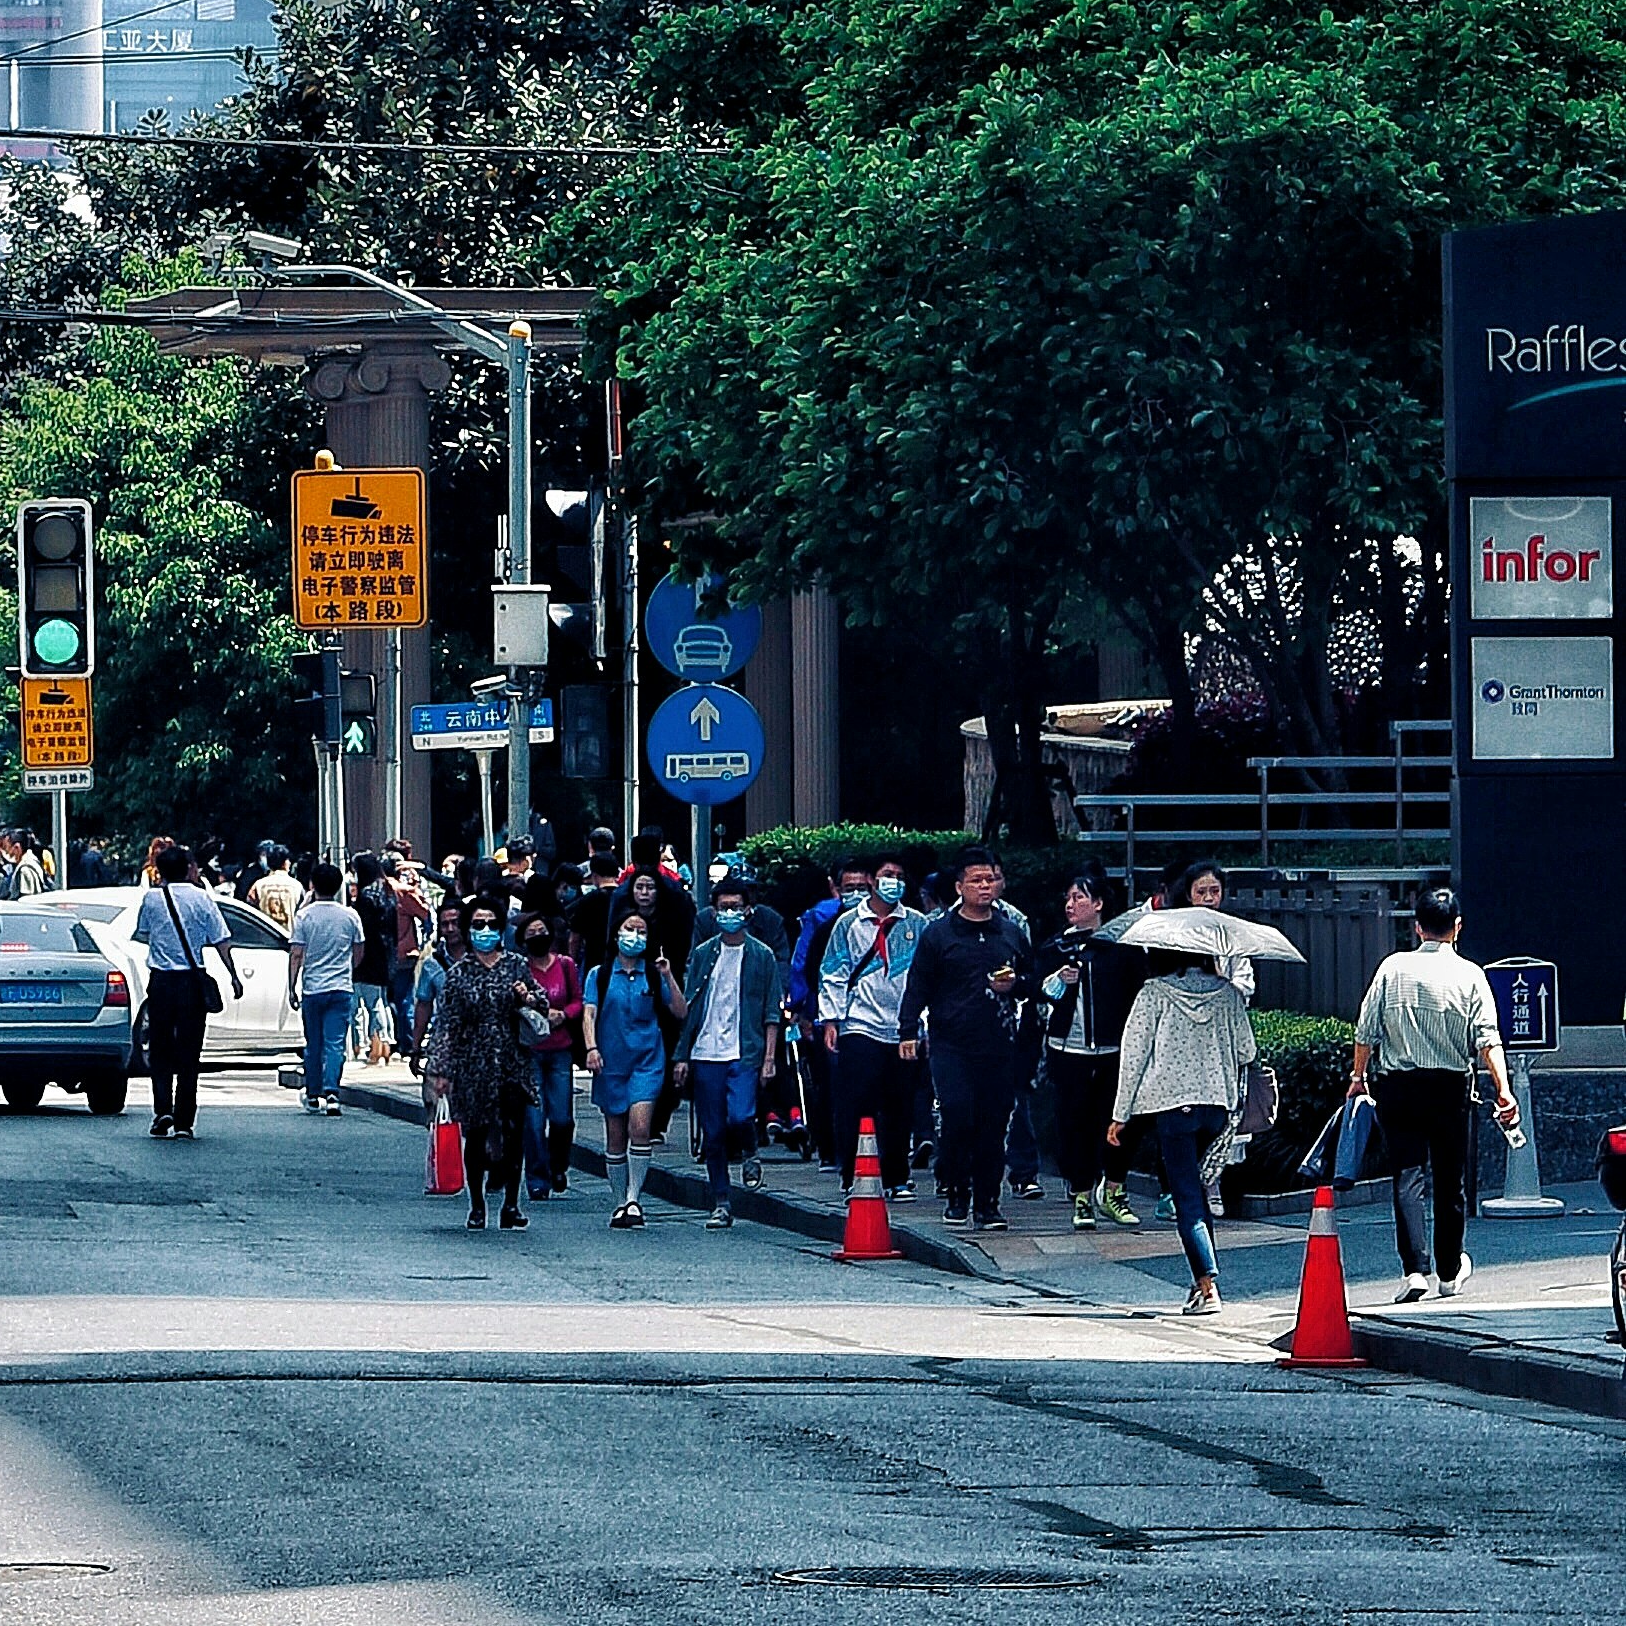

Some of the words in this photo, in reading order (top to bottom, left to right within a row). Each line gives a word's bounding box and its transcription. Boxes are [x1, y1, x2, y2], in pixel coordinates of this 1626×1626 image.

[301, 524, 414, 547] 停车行为违法
[309, 549, 404, 572] 请立即驶离
[1482, 533, 1601, 583] infor
[302, 574, 415, 596] 电子警察监管
[422, 737, 431, 746] N
[538, 731, 545, 740] S
[1512, 972, 1530, 1035] 人行通道
